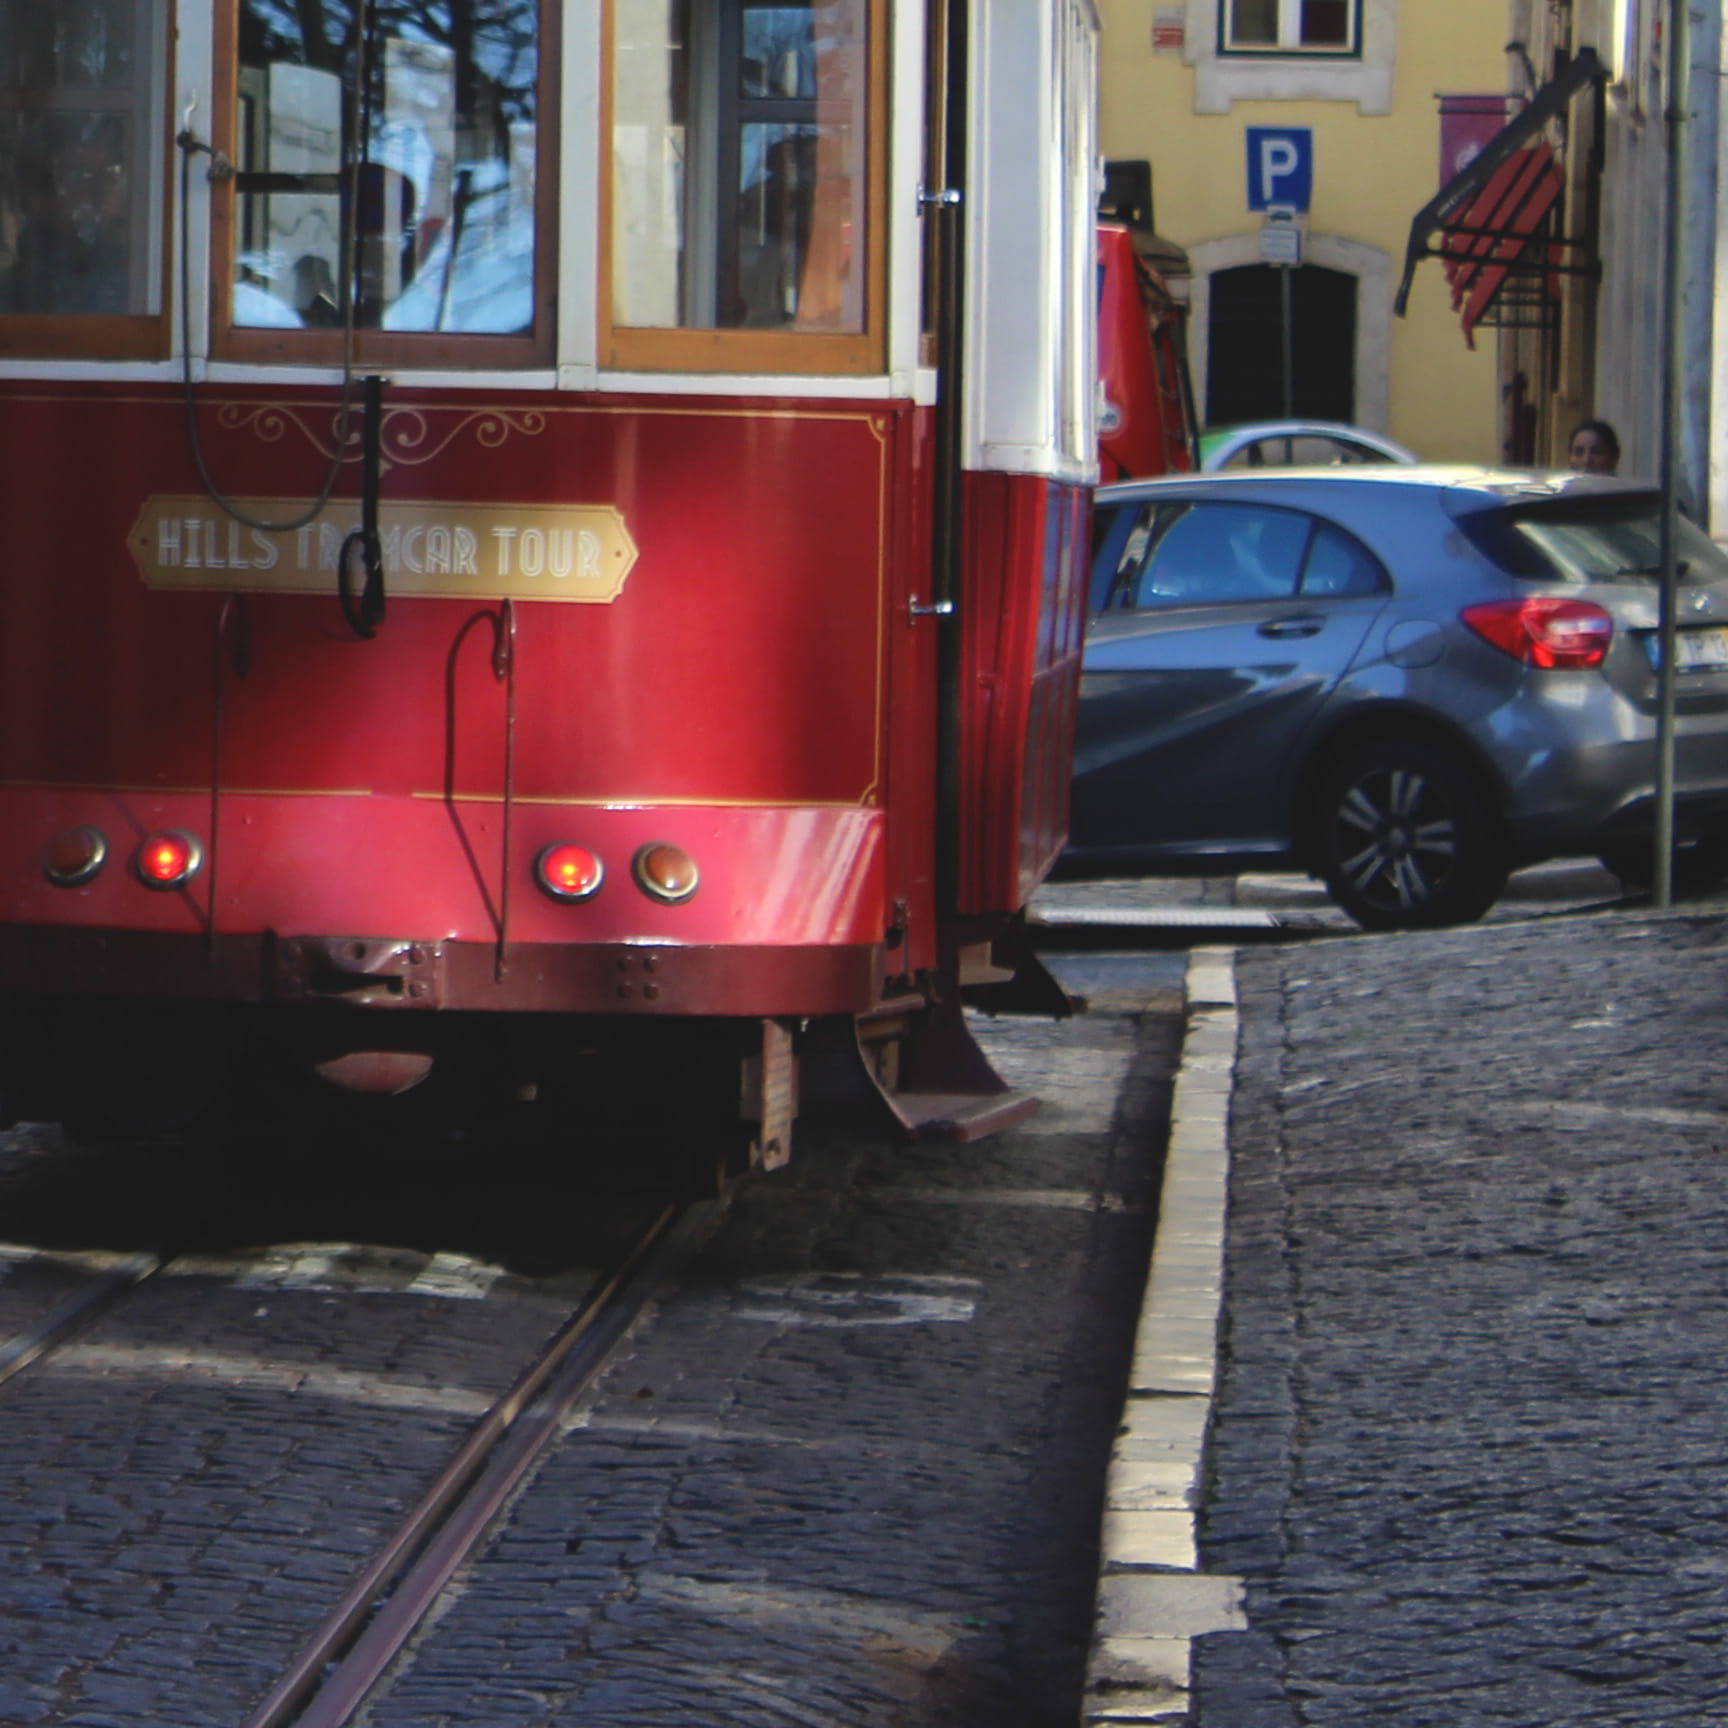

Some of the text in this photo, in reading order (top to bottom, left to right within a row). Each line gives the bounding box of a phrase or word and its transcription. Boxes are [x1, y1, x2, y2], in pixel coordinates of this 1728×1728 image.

[1261, 139, 1299, 201] P
[157, 518, 280, 571] HILLS
[491, 525, 603, 580] TOUR
